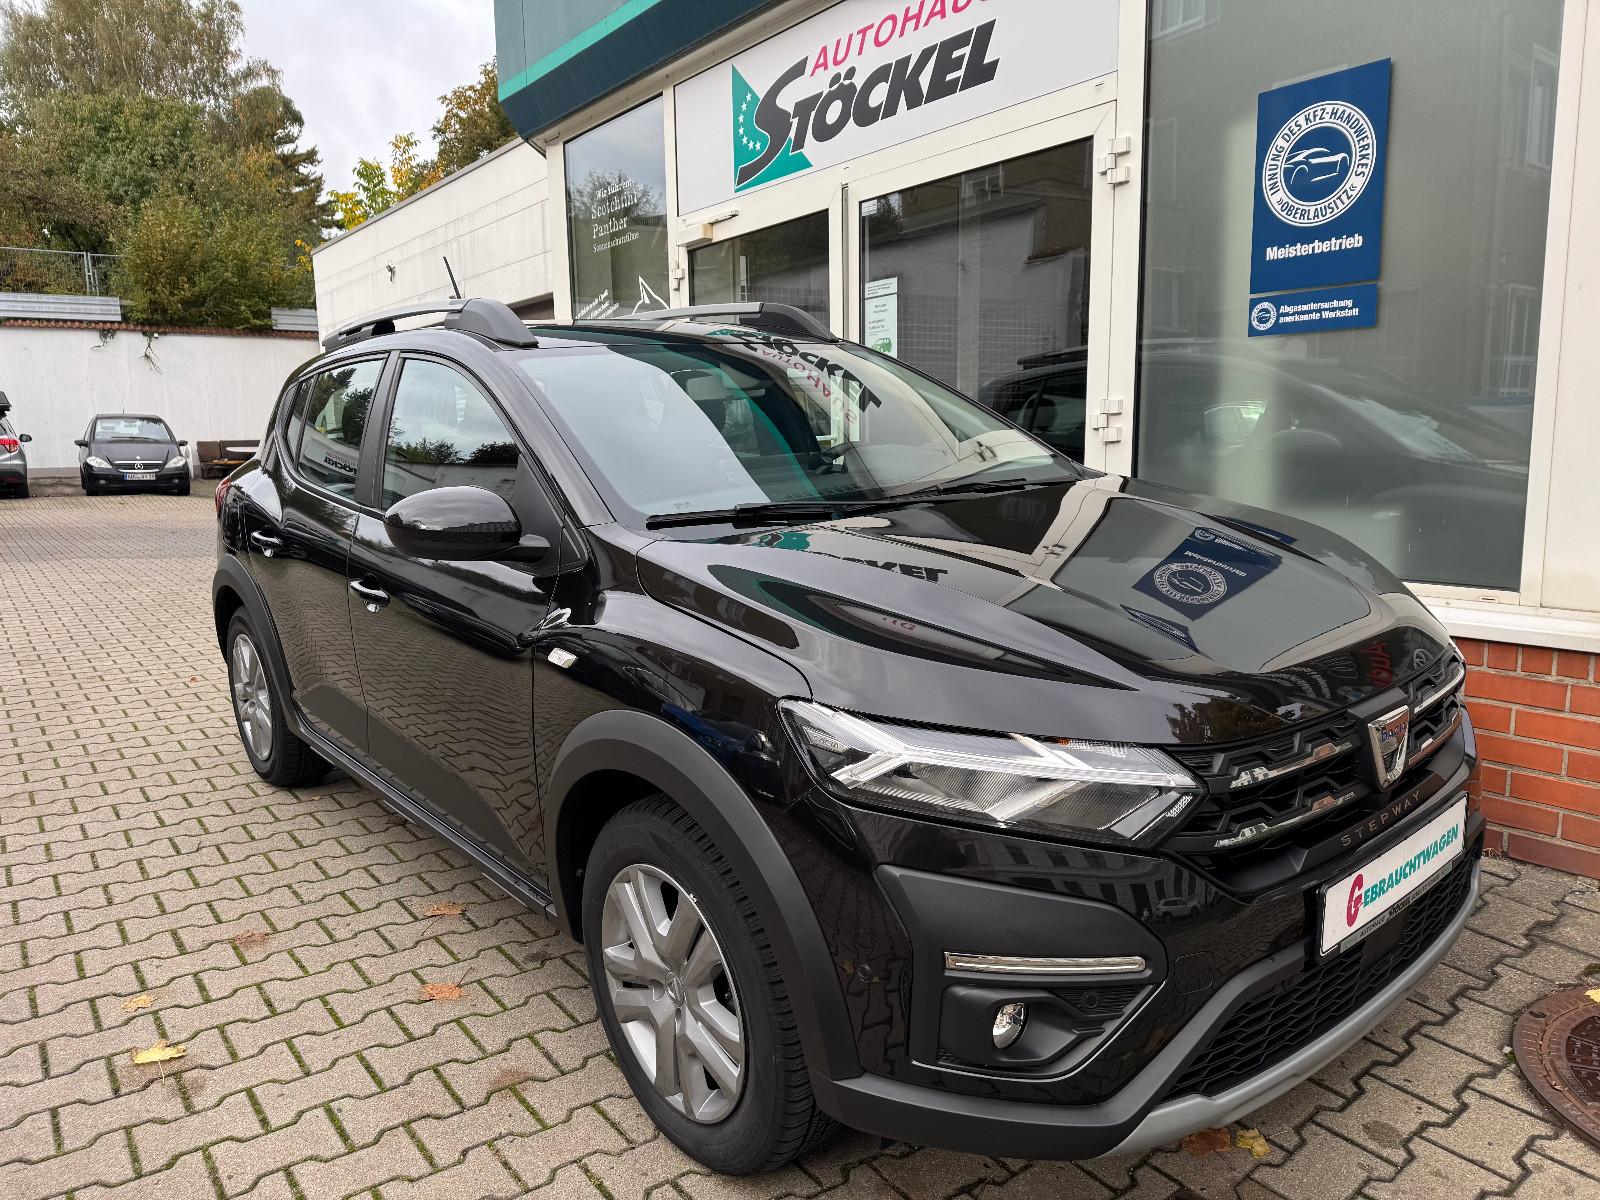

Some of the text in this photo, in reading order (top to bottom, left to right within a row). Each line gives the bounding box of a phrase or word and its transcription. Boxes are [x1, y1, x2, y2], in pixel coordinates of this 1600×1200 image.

[736, 18, 1000, 187] STÖCKEL
[1267, 105, 1371, 196] INNUNG DES KFZ-HANDWERKES
[592, 216, 628, 239] Panther
[1266, 233, 1363, 261] Meisterbetrieb
[1279, 308, 1359, 323] anerkannte Werkstatt
[1280, 299, 1353, 313] Abgasuntersuchung
[1340, 789, 1421, 847] STEPWAY
[1346, 824, 1459, 928] GEBRAUCHTWAGEN
